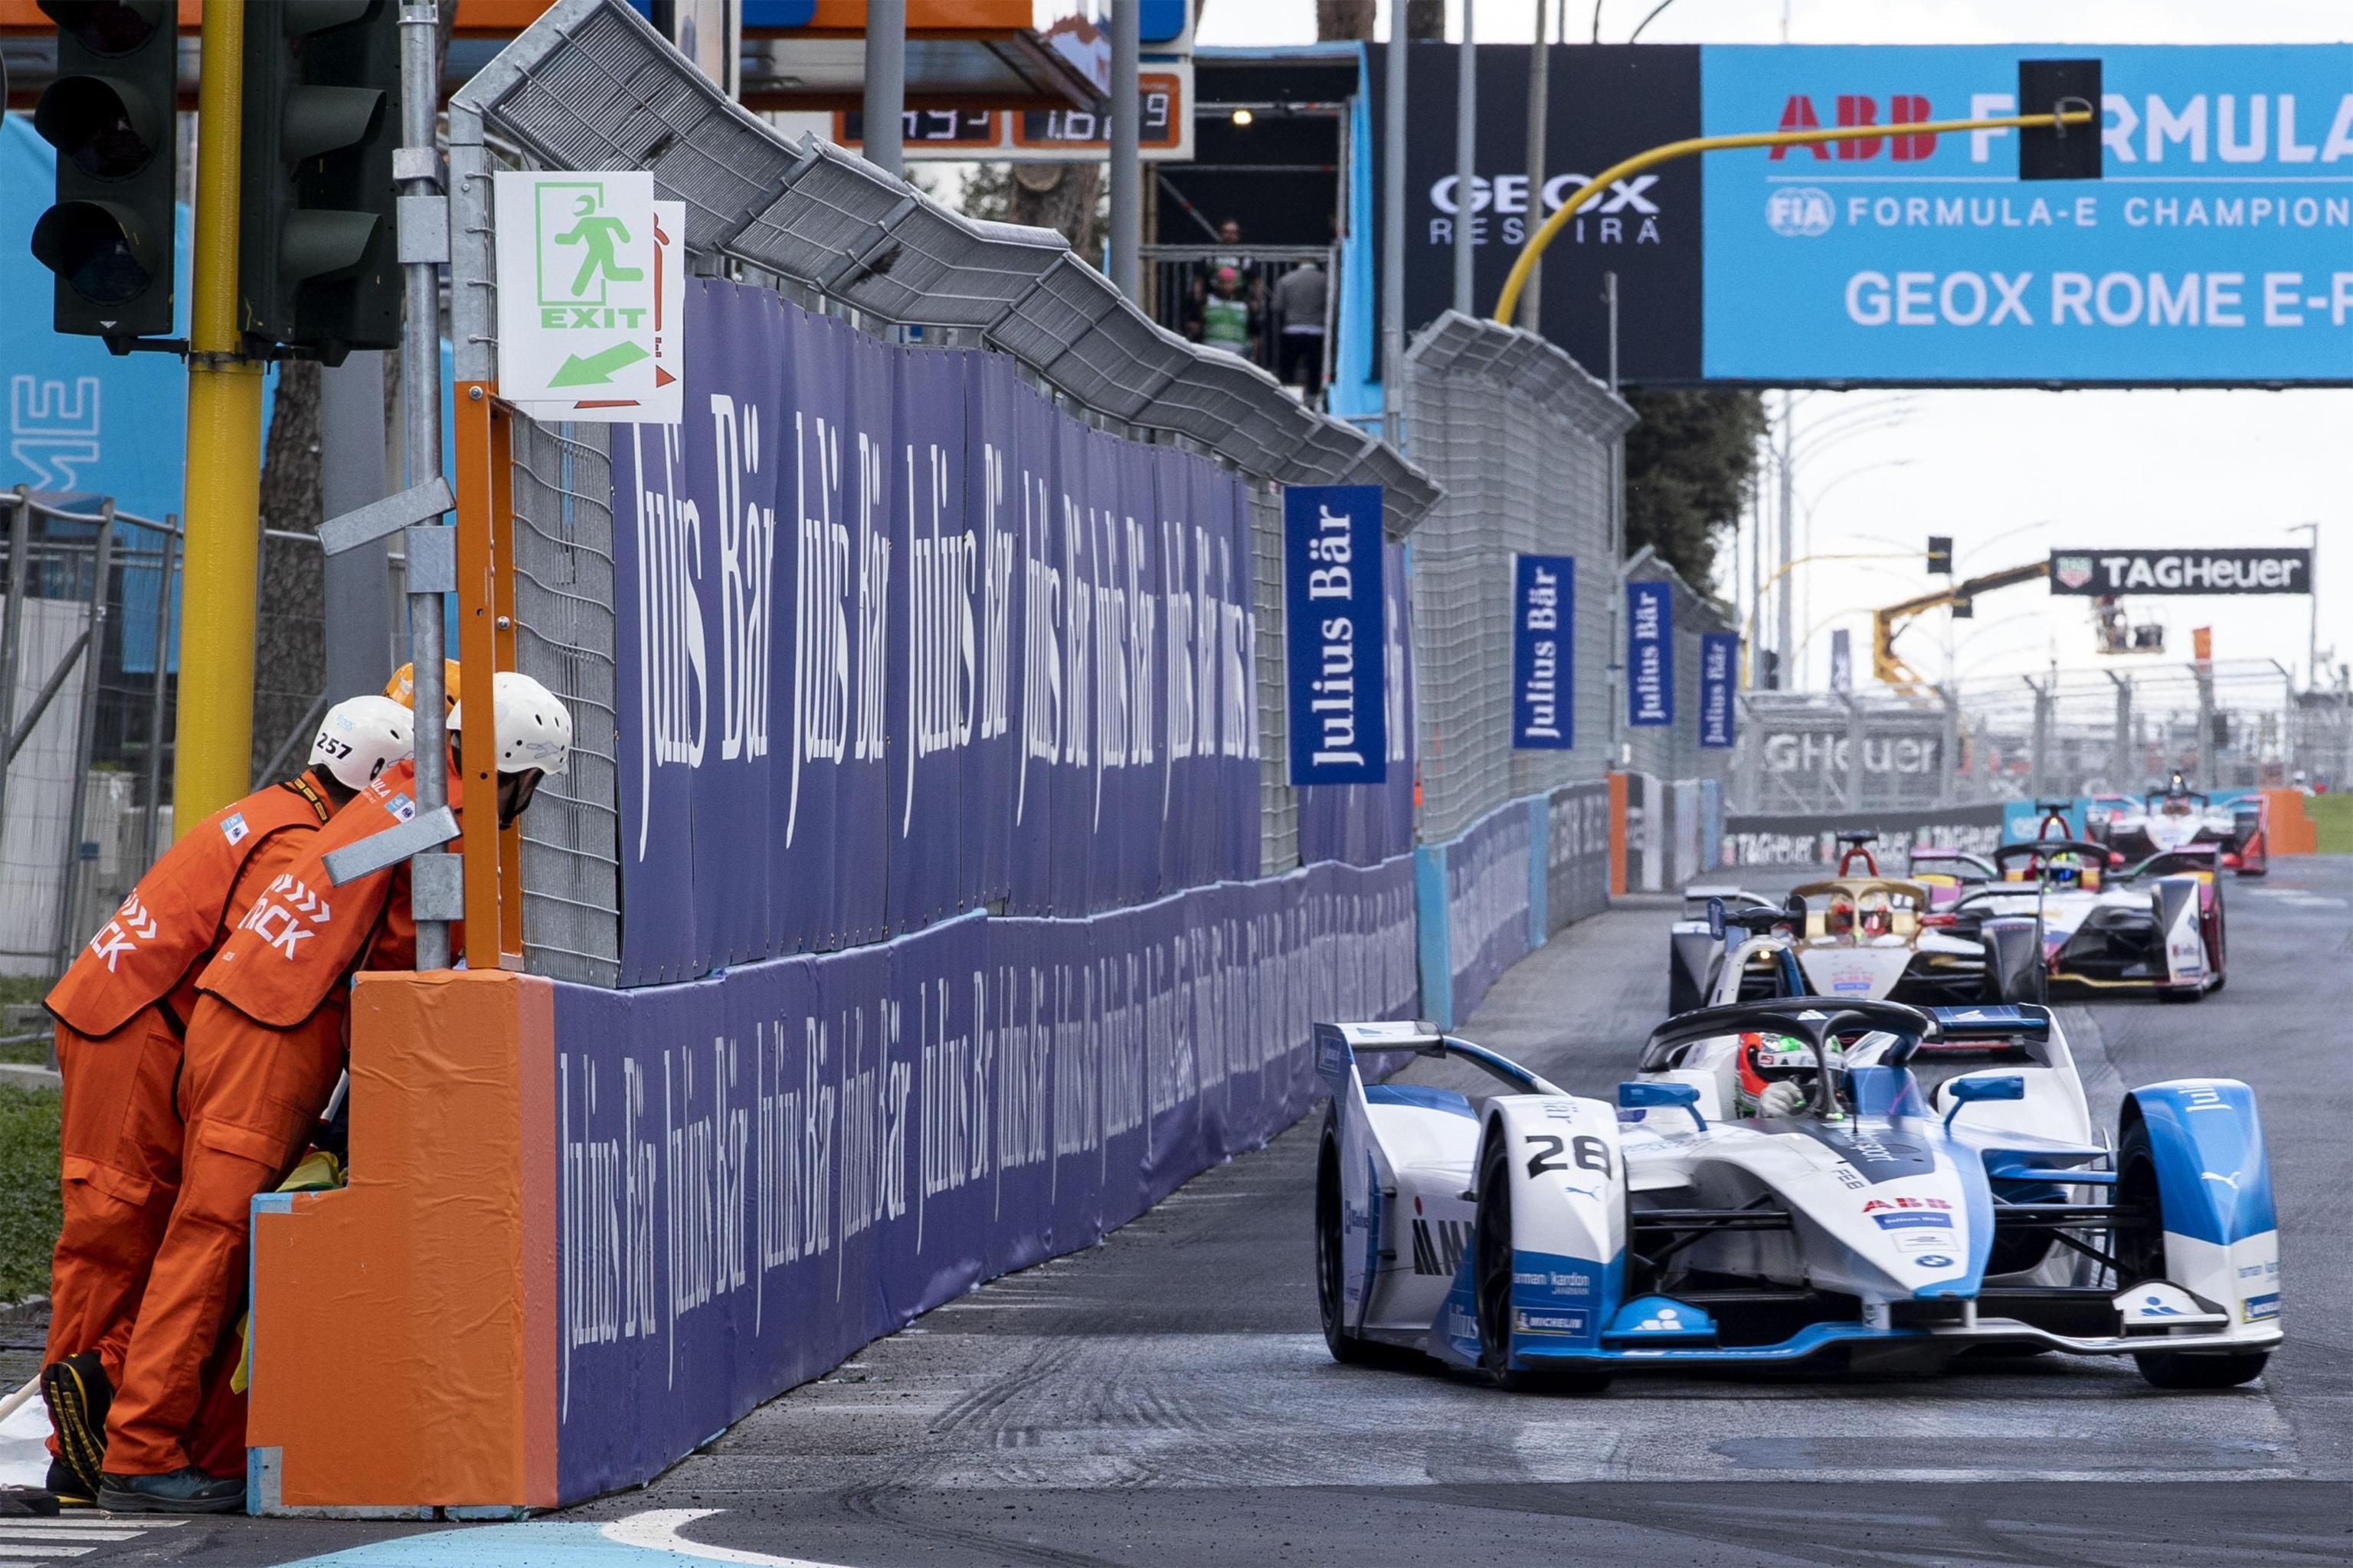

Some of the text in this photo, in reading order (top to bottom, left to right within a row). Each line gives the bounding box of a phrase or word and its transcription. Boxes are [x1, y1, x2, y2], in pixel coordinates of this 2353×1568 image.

[1768, 93, 2353, 162] ABB FRMUL
[1429, 173, 1661, 215] GEOX
[1429, 218, 1661, 244] RESIRA
[1847, 197, 2097, 227] FORMULA-E
[2123, 196, 2350, 227] CHAMPION
[541, 308, 647, 329] EXIT
[1845, 271, 2032, 326] GEOX
[2051, 270, 2246, 327] ROME
[711, 394, 774, 764] Bär
[855, 432, 889, 764] Bär
[2099, 555, 2302, 588] TAGHeuer
[903, 444, 977, 840] Julius
[1309, 505, 1365, 767] Julius Bär
[1525, 565, 1561, 738] Julius Bär
[1635, 591, 1667, 720] Julius Bär
[316, 732, 353, 760] 257
[836, 998, 911, 1303] Julius Bär
[917, 977, 968, 1256] Julius
[1525, 1134, 1612, 1180] 28
[664, 1036, 748, 1392] Julius Bär
[757, 1016, 835, 1338] Julius Bär
[1862, 1196, 1953, 1213] ABB
[560, 1052, 656, 1425] Julius Bär
[1529, 1317, 1584, 1329] MICHELIN
